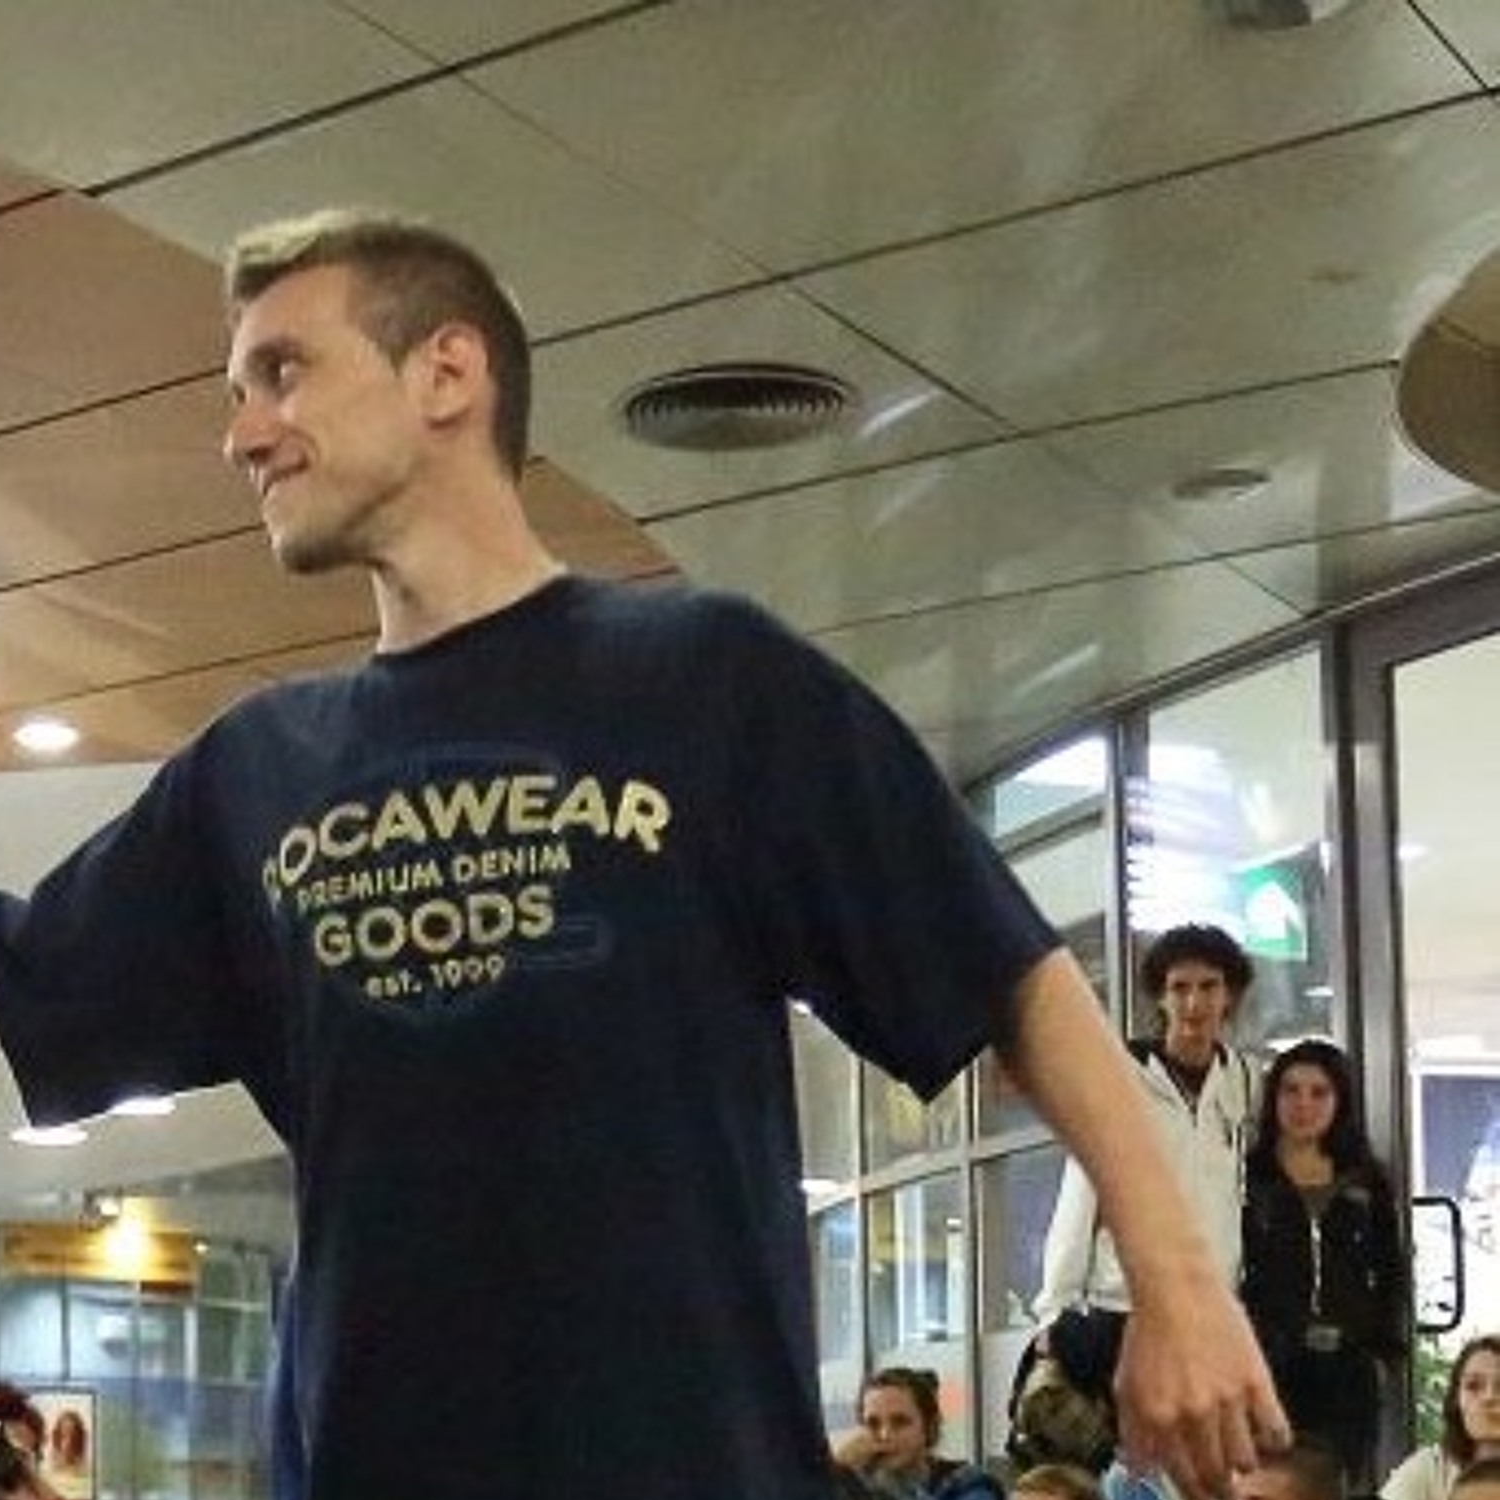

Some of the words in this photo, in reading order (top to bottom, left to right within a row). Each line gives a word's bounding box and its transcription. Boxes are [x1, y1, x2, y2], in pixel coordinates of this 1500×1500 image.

[297, 858, 444, 915] PREMIUM
[452, 843, 572, 884] DENIM
[314, 884, 554, 966] GOODS
[366, 968, 423, 998] est.
